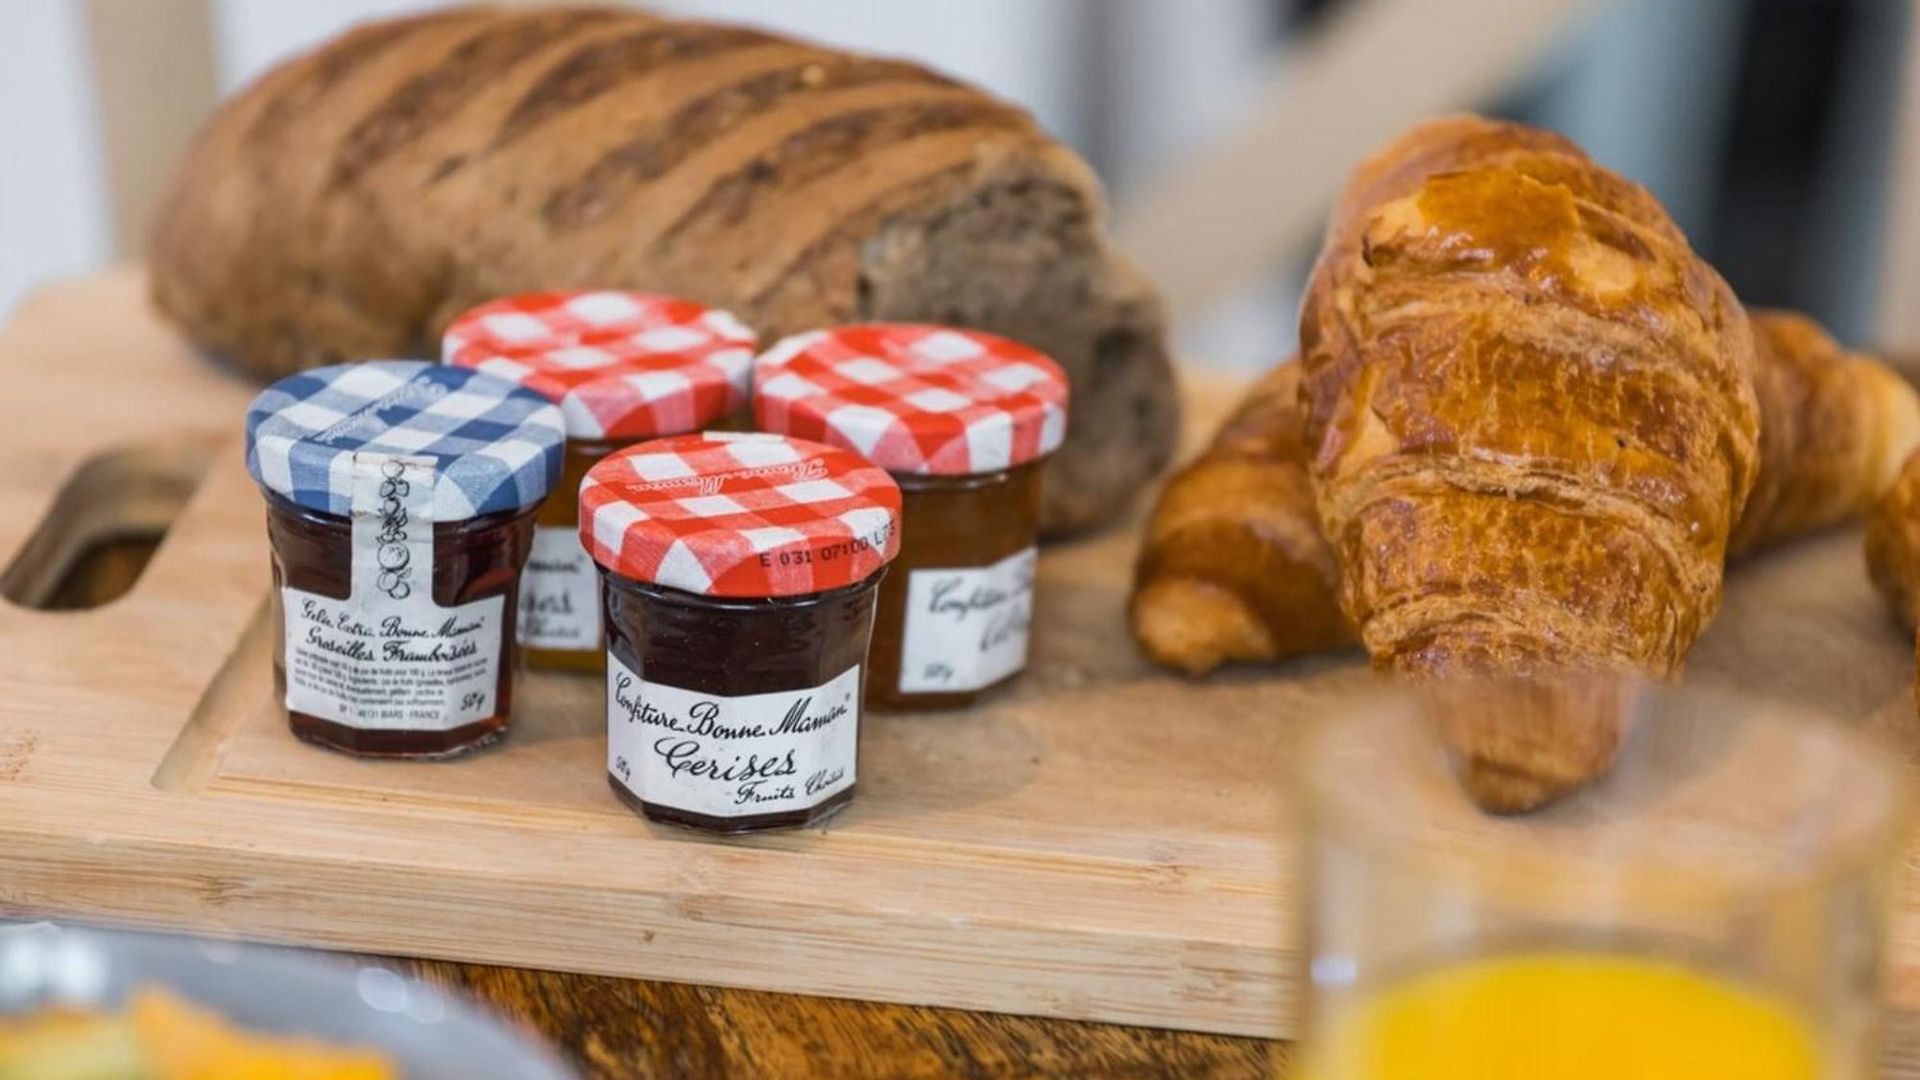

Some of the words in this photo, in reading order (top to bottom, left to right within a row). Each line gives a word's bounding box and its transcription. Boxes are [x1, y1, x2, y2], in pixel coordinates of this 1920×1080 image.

[760, 552, 772, 568] E
[779, 550, 812, 566] 031
[379, 615, 429, 638] Bonne
[305, 626, 377, 662] Groseilles
[615, 671, 685, 733] Confiture
[686, 701, 767, 740] Bonne
[653, 736, 798, 782] Cerises
[734, 779, 796, 805] Fruits
